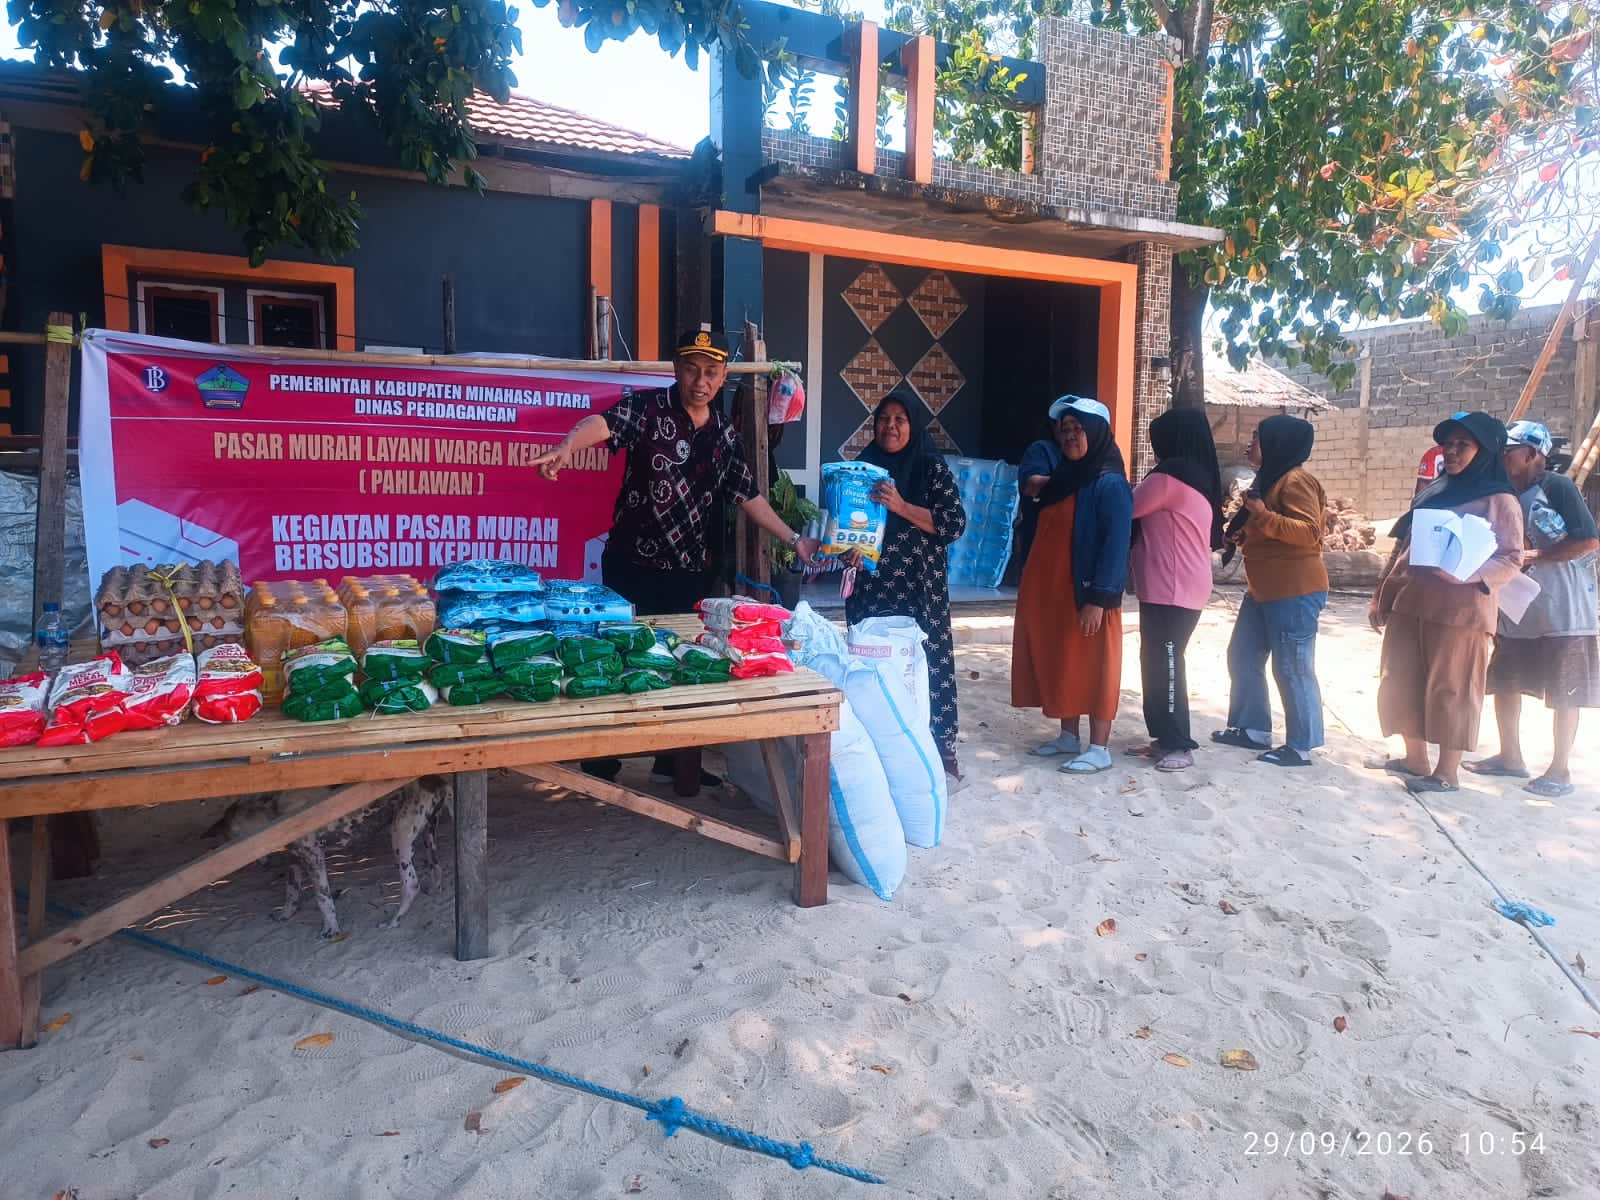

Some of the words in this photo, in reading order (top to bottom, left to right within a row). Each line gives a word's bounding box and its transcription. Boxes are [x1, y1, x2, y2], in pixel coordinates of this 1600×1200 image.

[269, 374, 371, 395] PEMERINTAH
[375, 380, 462, 400] KABUPATEN
[466, 385, 543, 406] MINAHASA
[545, 391, 591, 409] UTARA
[355, 398, 403, 416] DINAS
[406, 401, 517, 423] PERDAGANGAN
[214, 431, 283, 460] PASAR
[288, 433, 362, 461] MURAH
[367, 436, 430, 463] LAYANI
[434, 438, 503, 466] WARGA
[507, 442, 609, 471] KEPAUAN
[371, 469, 473, 496] PAHLAWAN
[272, 514, 390, 542] KEGIATAN
[396, 514, 471, 540] PASAR
[477, 515, 559, 542] MURAH
[275, 541, 423, 571] BERSUBSIDI
